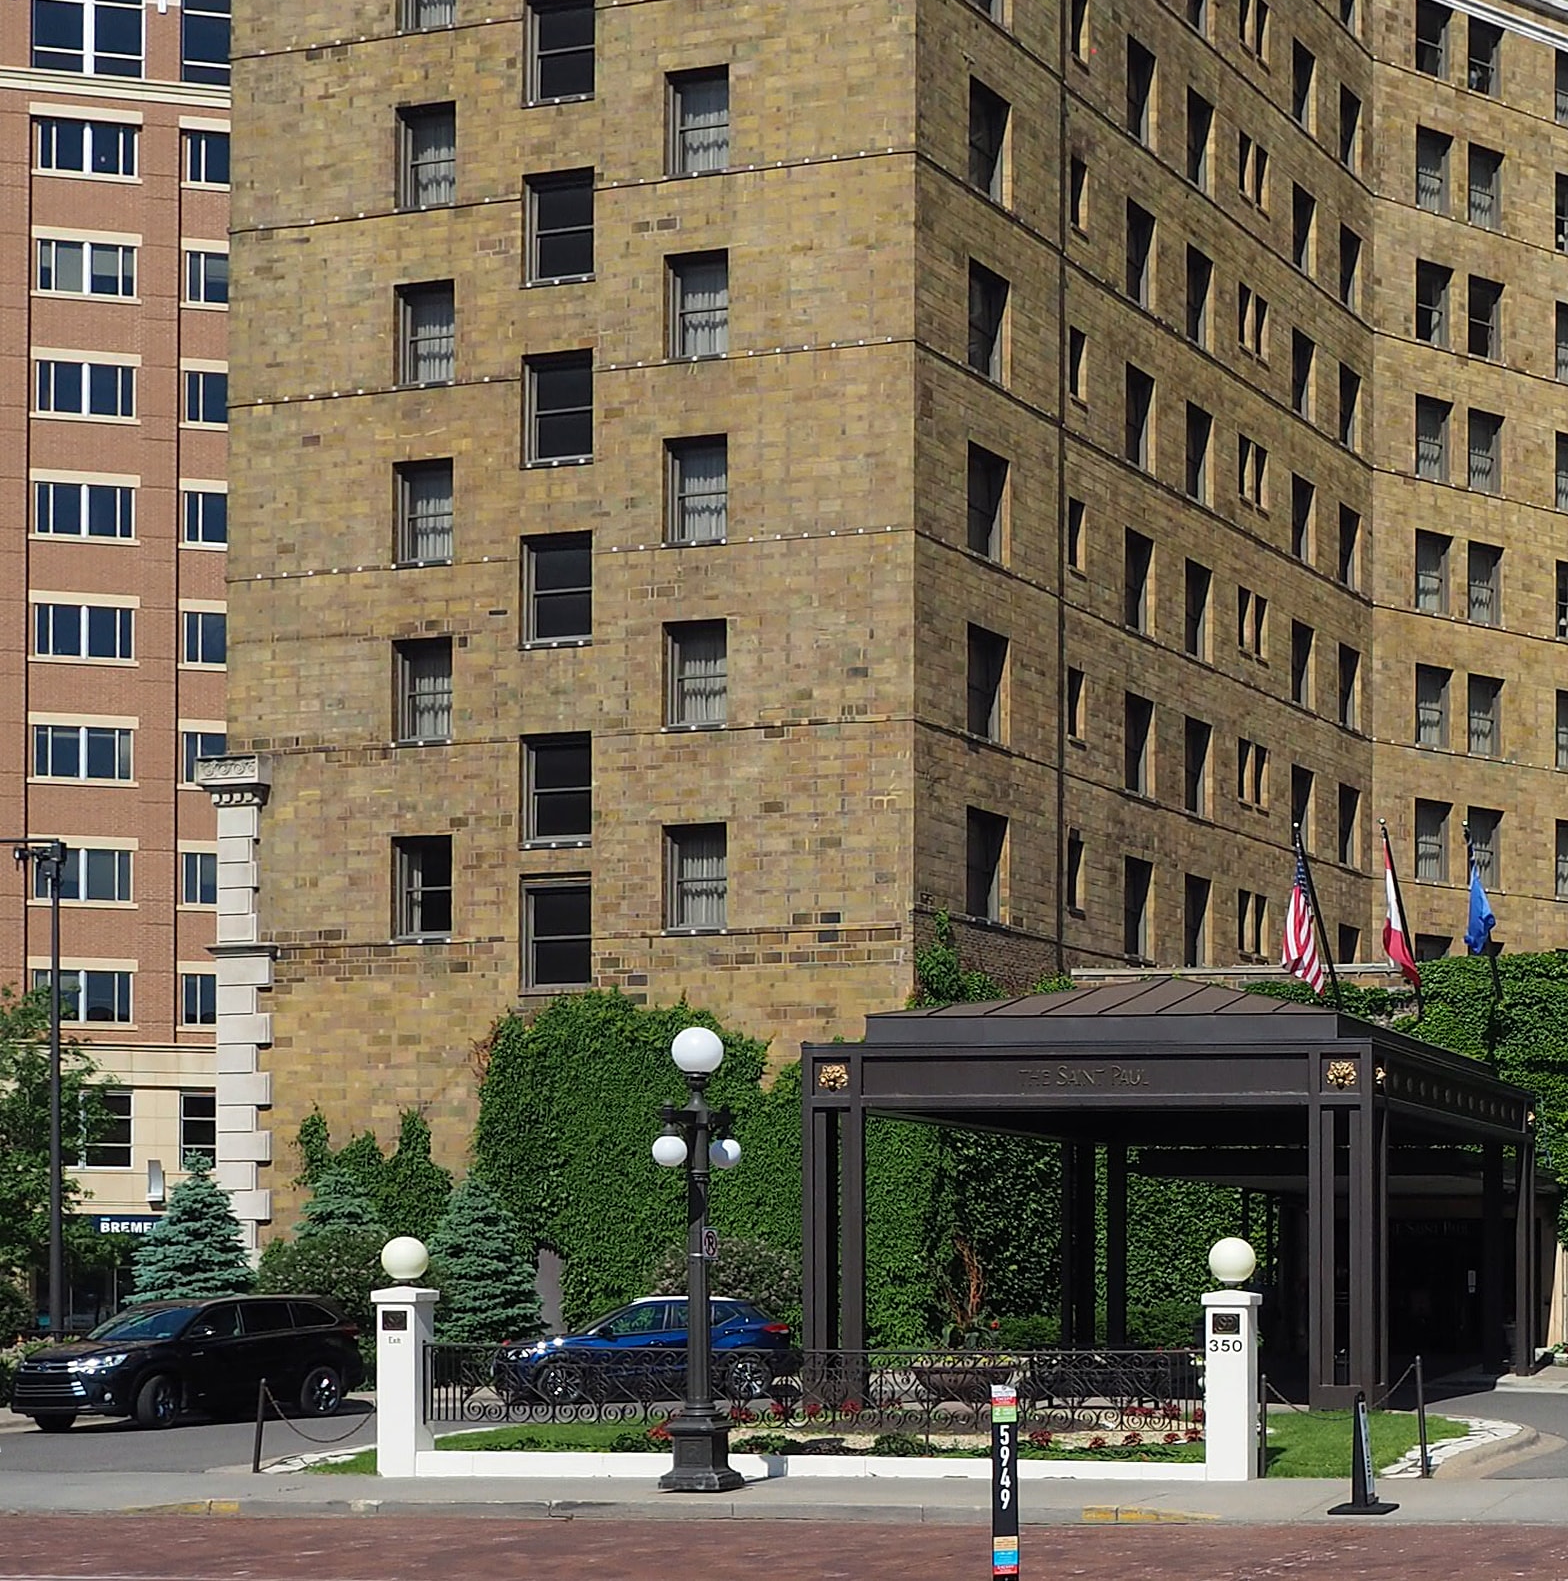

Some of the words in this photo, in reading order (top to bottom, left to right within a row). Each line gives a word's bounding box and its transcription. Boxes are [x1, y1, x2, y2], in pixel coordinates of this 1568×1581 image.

[1019, 1069, 1051, 1087] THE
[1056, 1065, 1105, 1087] SAINT
[1111, 1065, 1150, 1087] PAUL
[100, 1221, 156, 1234] BREME
[1209, 1339, 1243, 1353] 350
[1000, 1425, 1011, 1510] 5949
